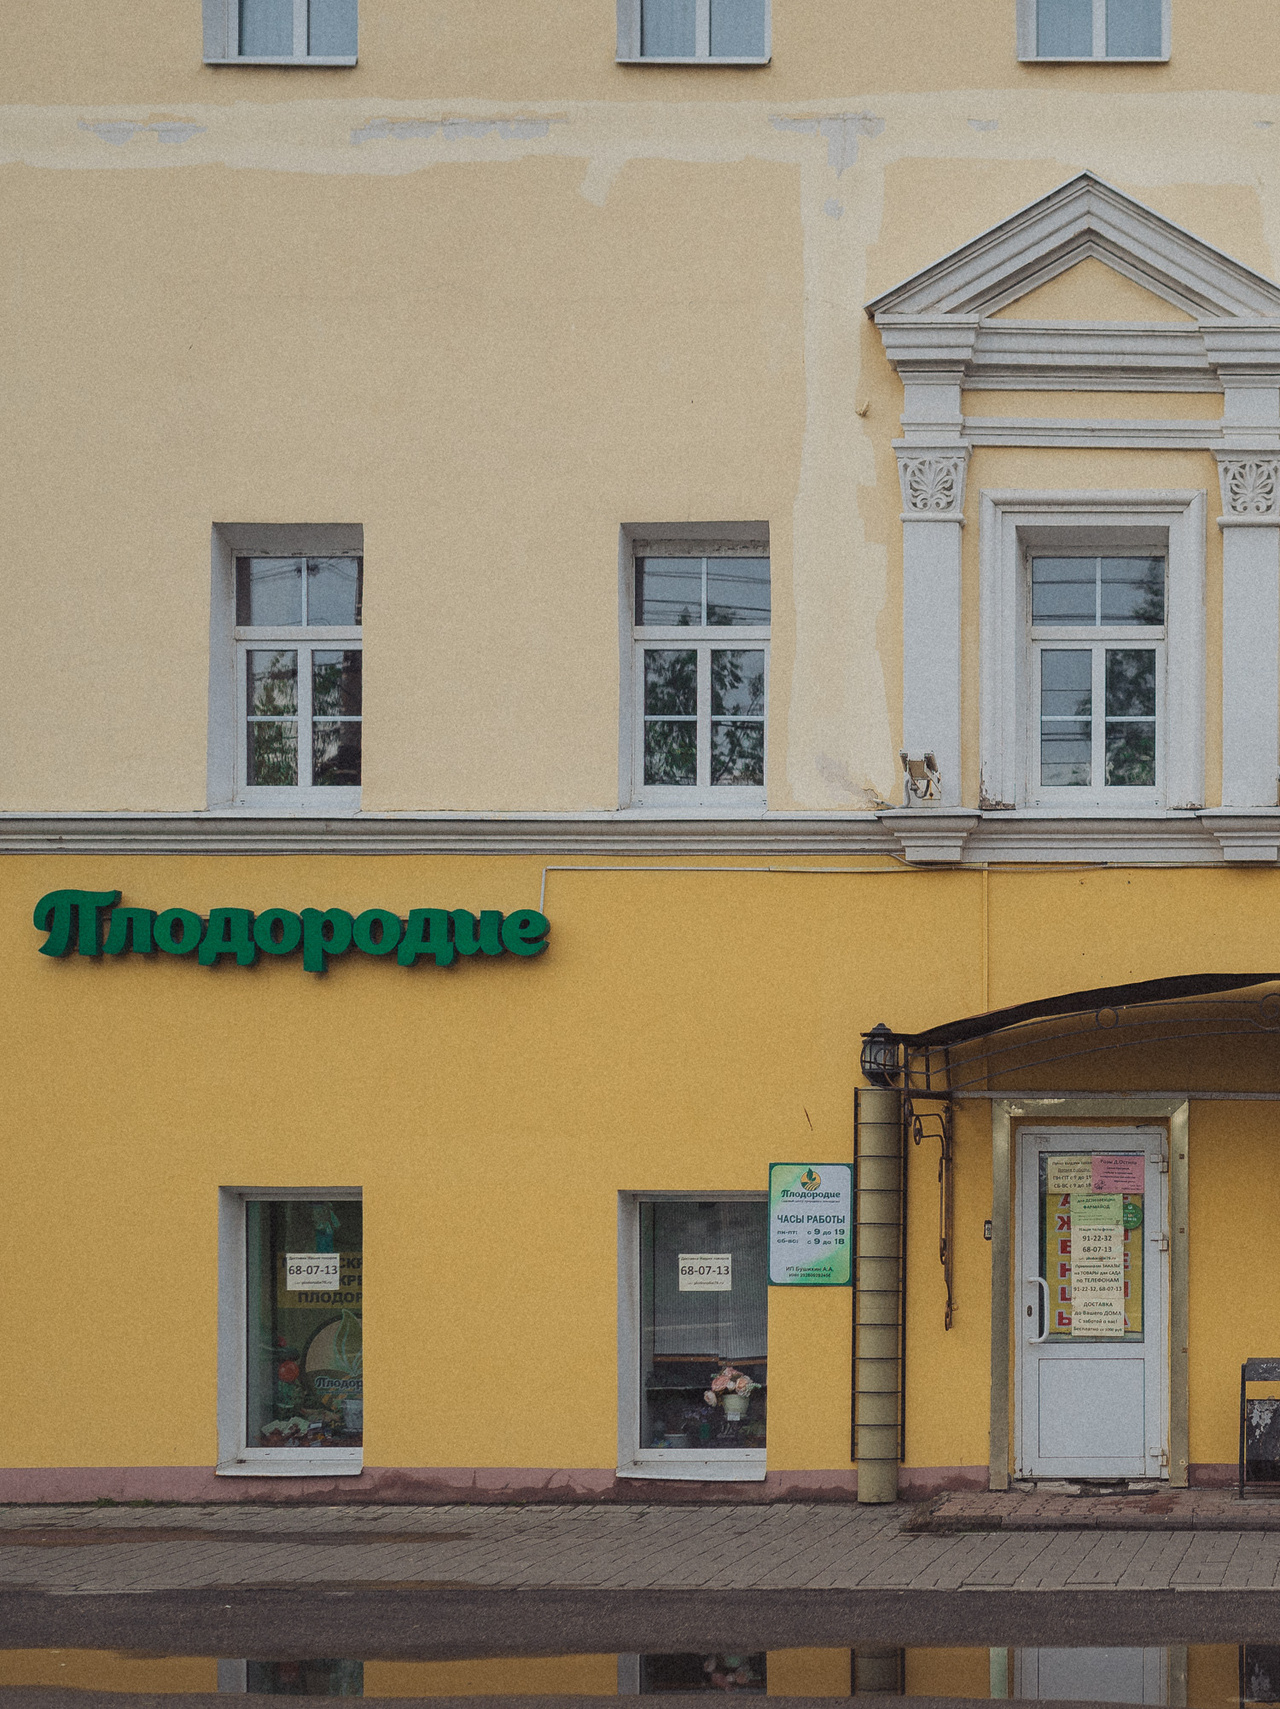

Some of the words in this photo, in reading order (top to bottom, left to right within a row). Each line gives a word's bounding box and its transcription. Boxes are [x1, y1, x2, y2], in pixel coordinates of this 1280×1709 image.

[33, 889, 549, 972] Плодородие
[781, 1189, 841, 1199] Плодородие
[777, 1215, 804, 1223] ЧАСЫ
[806, 1215, 845, 1223] РАБОТЫ
[288, 1265, 338, 1275] 68-07-13
[680, 1266, 730, 1275] 68-07-13
